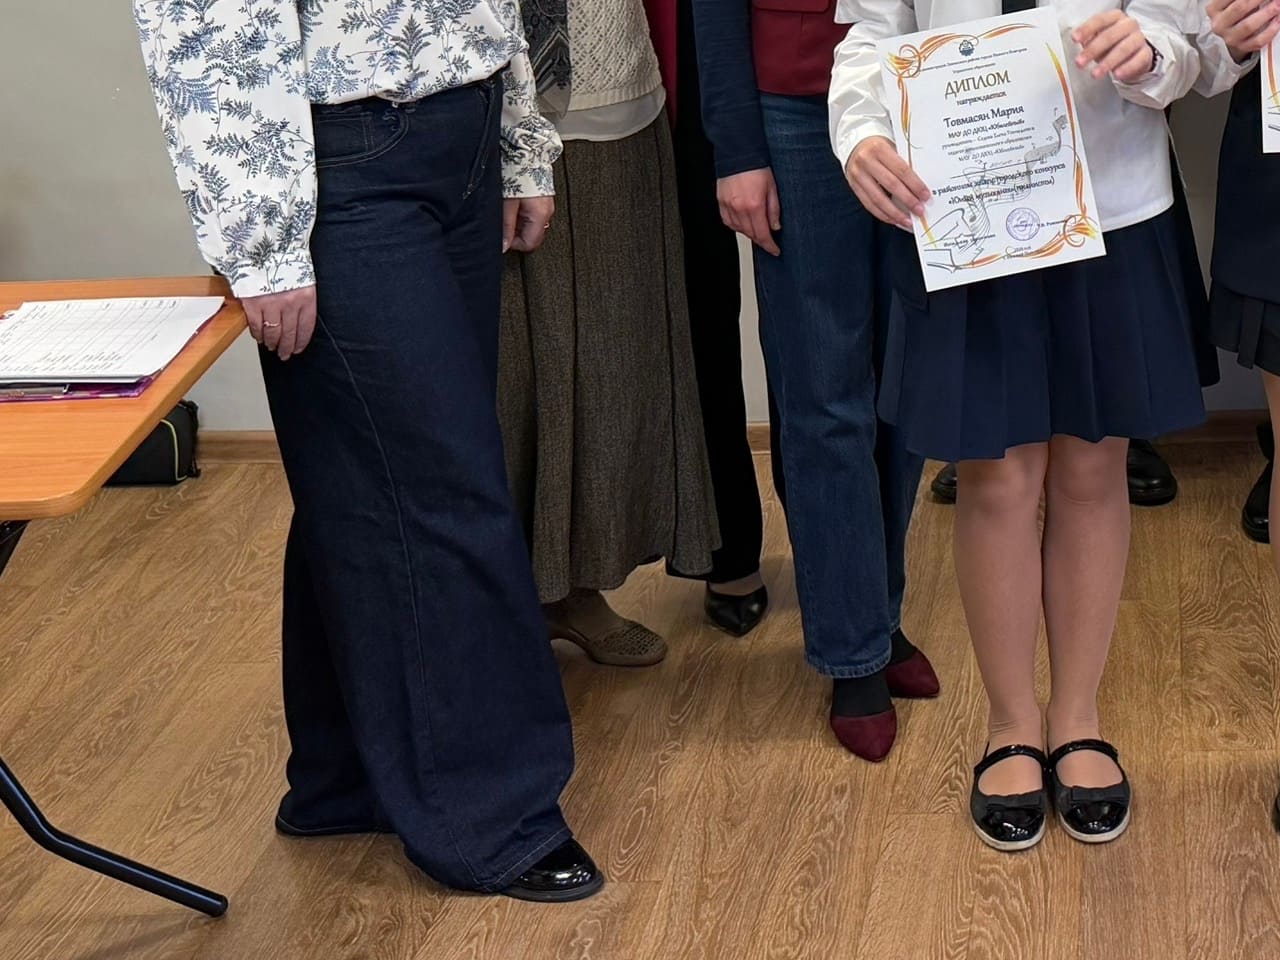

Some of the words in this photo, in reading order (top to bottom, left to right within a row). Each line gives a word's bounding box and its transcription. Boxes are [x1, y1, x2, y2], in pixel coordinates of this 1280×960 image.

[945, 70, 1010, 99] ДИПЛОМ
[957, 91, 1007, 106] награждается
[943, 114, 990, 128] Товмасян
[991, 105, 1024, 119] Мария
[938, 184, 972, 197] районном
[1034, 163, 1065, 177] конкурса
